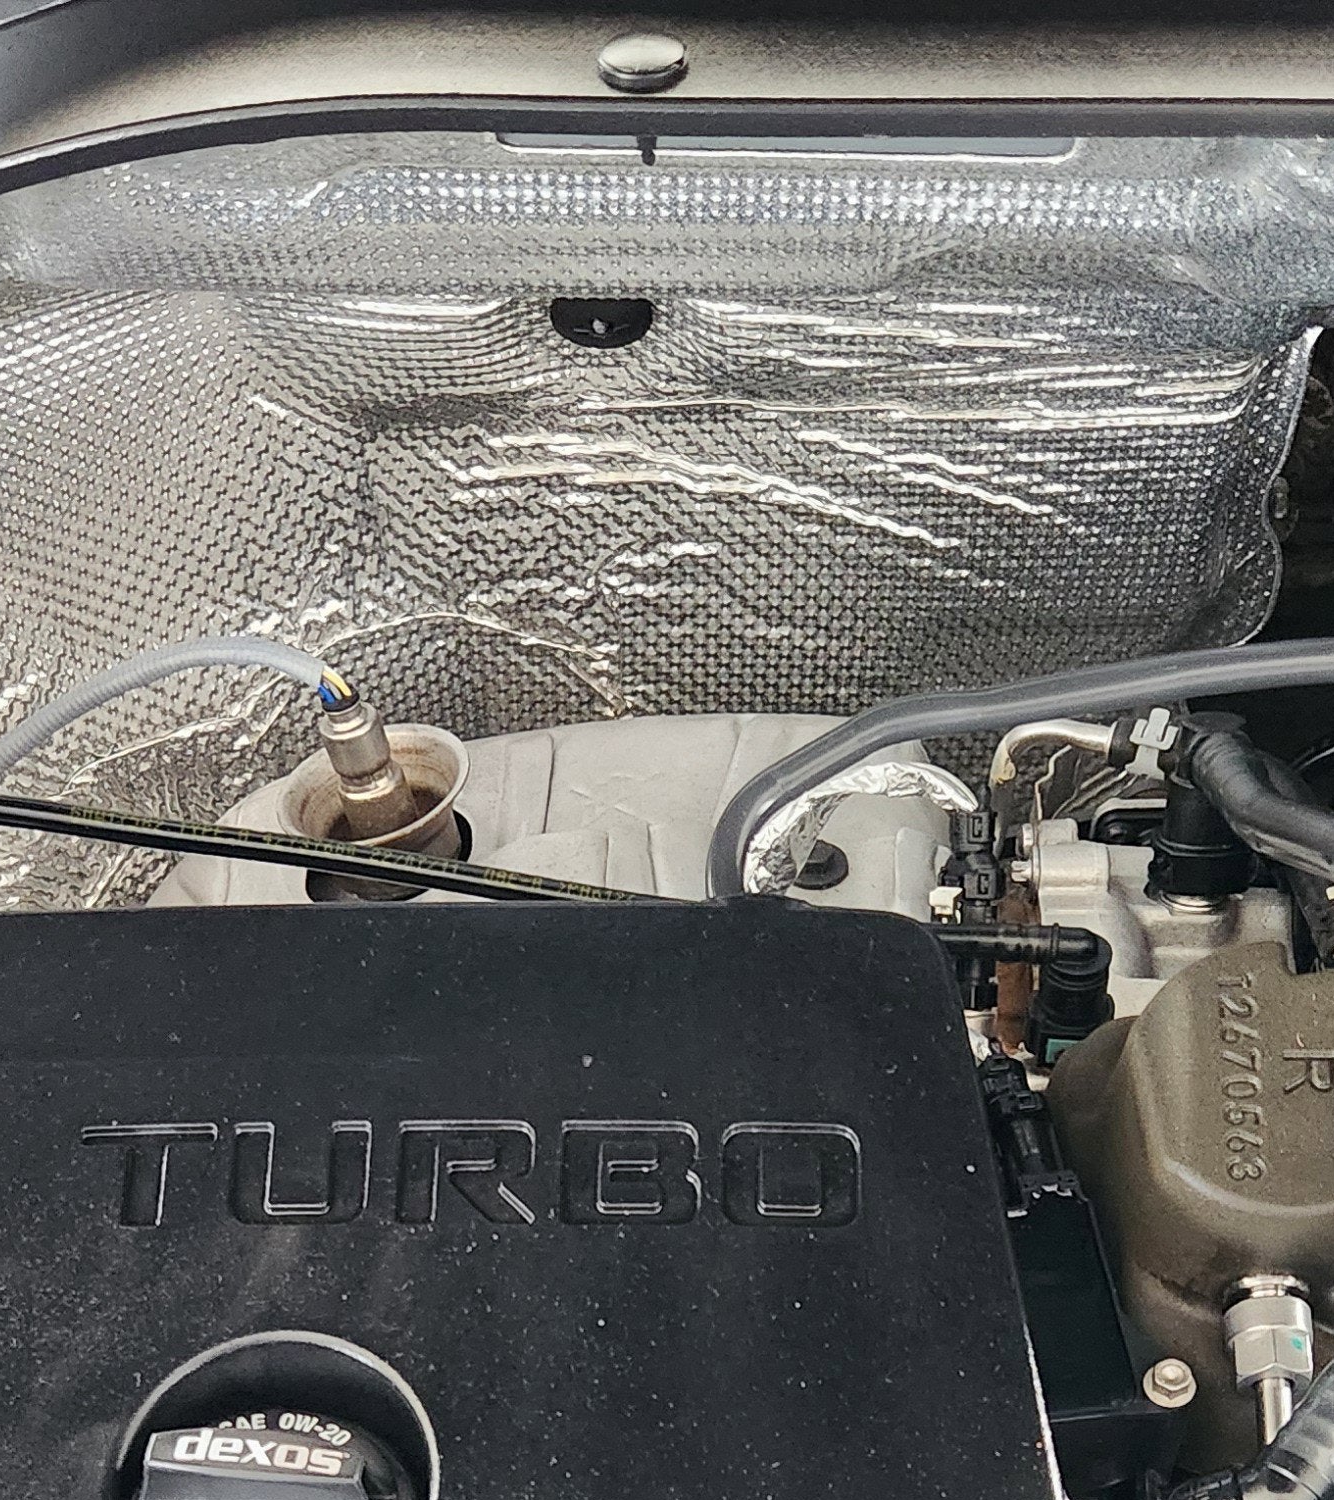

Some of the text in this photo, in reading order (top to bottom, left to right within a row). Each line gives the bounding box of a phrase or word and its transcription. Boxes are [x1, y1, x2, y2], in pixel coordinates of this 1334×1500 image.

[1218, 972, 1268, 1182] 12670563
[81, 1119, 863, 1228] TURBO
[172, 1428, 347, 1477] dexos
[278, 1411, 353, 1447] 0W-20
